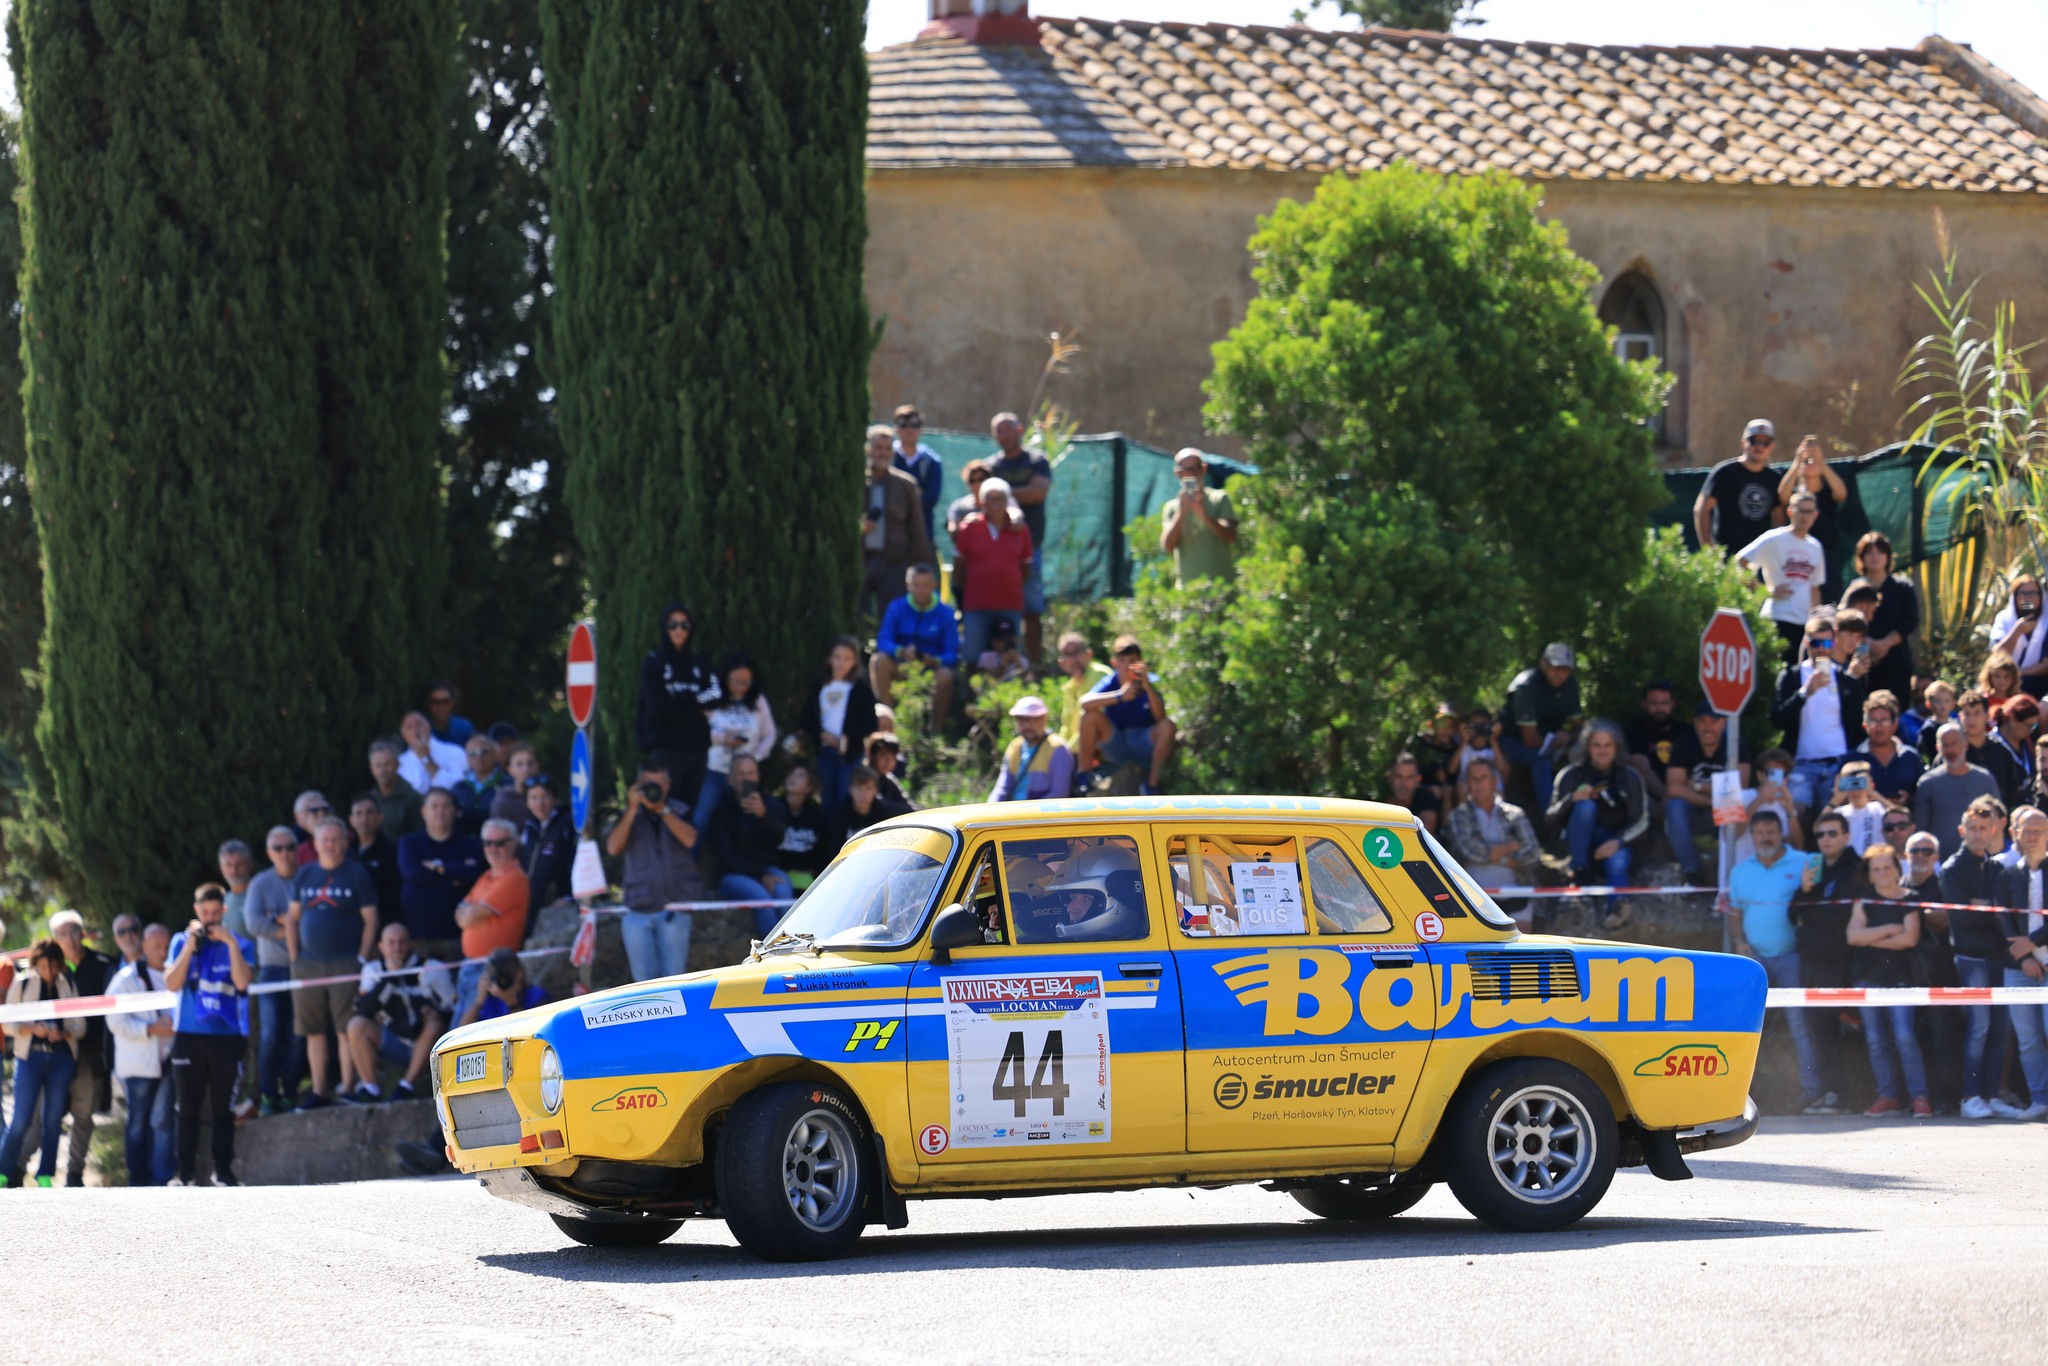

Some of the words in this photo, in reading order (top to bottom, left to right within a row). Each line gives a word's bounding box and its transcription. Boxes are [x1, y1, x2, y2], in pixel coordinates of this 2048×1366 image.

[1703, 643, 1750, 685] STOP
[1375, 835, 1392, 858] 2
[1210, 904, 1228, 924] R
[1234, 903, 1288, 924] Touš
[1421, 917, 1438, 936] E
[796, 972, 828, 980] Radek
[799, 981, 830, 991] Lukáš
[833, 980, 868, 989] Hronek
[1030, 978, 1073, 997] ELBA
[1212, 948, 1694, 1036] Barum
[587, 1007, 644, 1026] PLZEŇSKÝ
[646, 1005, 673, 1016] KRAJ
[1000, 1000, 1058, 1012] LOCMAN
[843, 1019, 901, 1052] P1
[1212, 1053, 1305, 1067] Autocentrum
[1309, 1051, 1335, 1063] Jan
[1339, 1046, 1396, 1062] Šmucler
[1664, 1055, 1718, 1077] SATO
[992, 1029, 1070, 1118] 44
[1253, 1072, 1396, 1100] šmucler
[616, 1093, 658, 1111] SATO
[1252, 1111, 1280, 1121] Plzeň,
[1283, 1108, 1334, 1119] Horšovský
[1336, 1107, 1356, 1118] Týn,
[1358, 1107, 1396, 1117] Klatovy
[929, 1129, 941, 1146] E
[958, 1124, 990, 1132] LOCMAN
